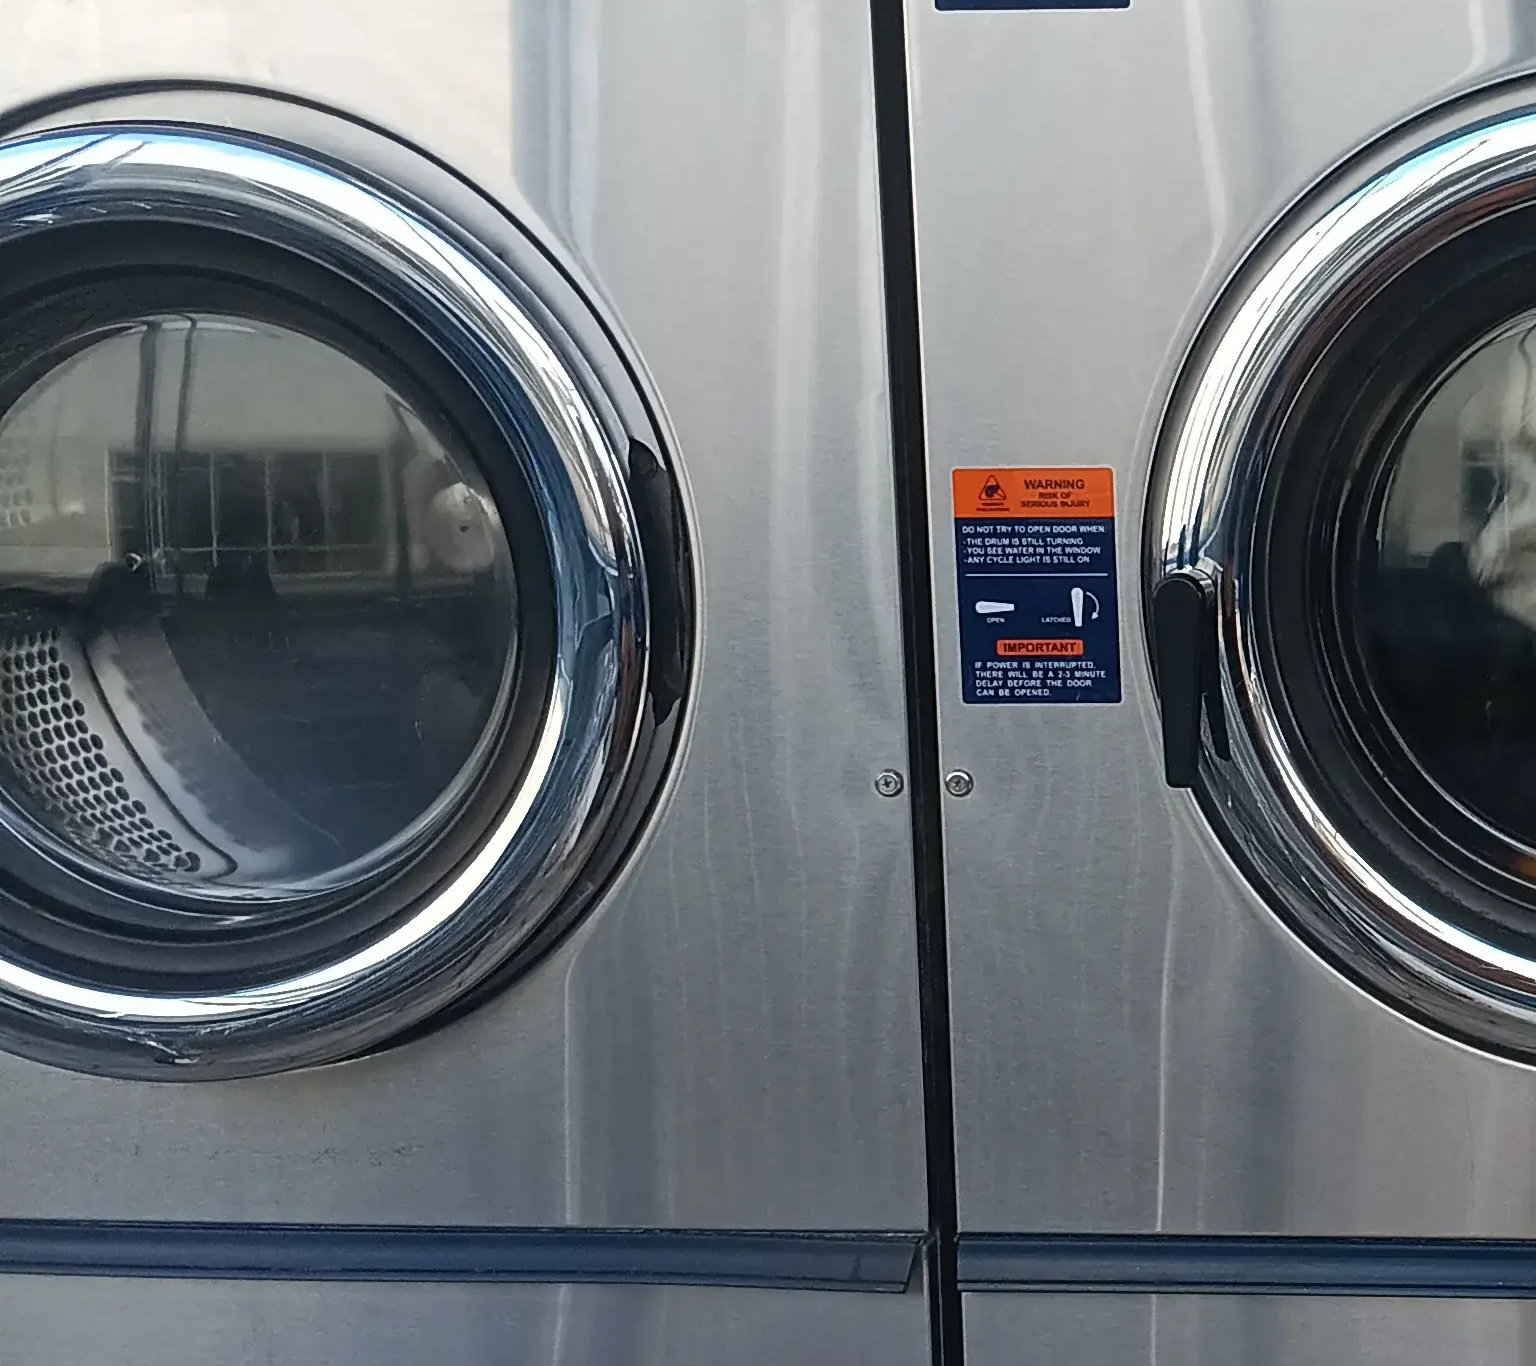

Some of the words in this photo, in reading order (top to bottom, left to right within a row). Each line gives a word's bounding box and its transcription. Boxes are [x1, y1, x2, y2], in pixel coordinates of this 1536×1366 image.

[1023, 479, 1085, 490] WARNING
[1038, 491, 1059, 500] RISK
[1060, 491, 1073, 499] OF
[1020, 500, 1059, 508] SERIOUS
[1059, 500, 1091, 508] INJURY
[962, 525, 975, 534] DO
[976, 525, 994, 534] NOT
[996, 525, 1013, 534] TRY
[1014, 525, 1026, 533] TO
[1027, 525, 1051, 533] OPEN
[1052, 525, 1077, 533] DOOR
[984, 537, 1010, 546] DRUM
[1011, 537, 1020, 546] IS
[1021, 537, 1044, 546] STILL
[1046, 537, 1083, 545] TURNING
[986, 546, 1003, 555] SEE
[1004, 546, 1034, 555] WATER
[1035, 546, 1045, 554] IN
[1046, 546, 1063, 554] THE
[1064, 546, 1101, 554] WINDOW
[986, 556, 1014, 564] CYCLE
[1016, 556, 1041, 564] LIGHT
[1042, 555, 1051, 564] IS
[1052, 555, 1076, 564] STILL
[1076, 555, 1090, 564] ON
[1003, 642, 1077, 653] IMPORTANT
[974, 661, 983, 669] IF
[986, 661, 1019, 669] POWER
[1022, 661, 1031, 669] IS
[975, 670, 1003, 678] THERE
[1007, 670, 1028, 678] WILL
[1032, 670, 1044, 678] BE
[1047, 670, 1054, 678] A
[1057, 670, 1070, 678] 2-3
[1074, 670, 1106, 678] MINUTE
[975, 679, 1003, 687] DELAY
[1007, 679, 1042, 687] BEFORE
[1045, 679, 1063, 687] THE
[1066, 679, 1093, 687] DOOR
[976, 688, 995, 697] CAN
[998, 688, 1010, 697] BE
